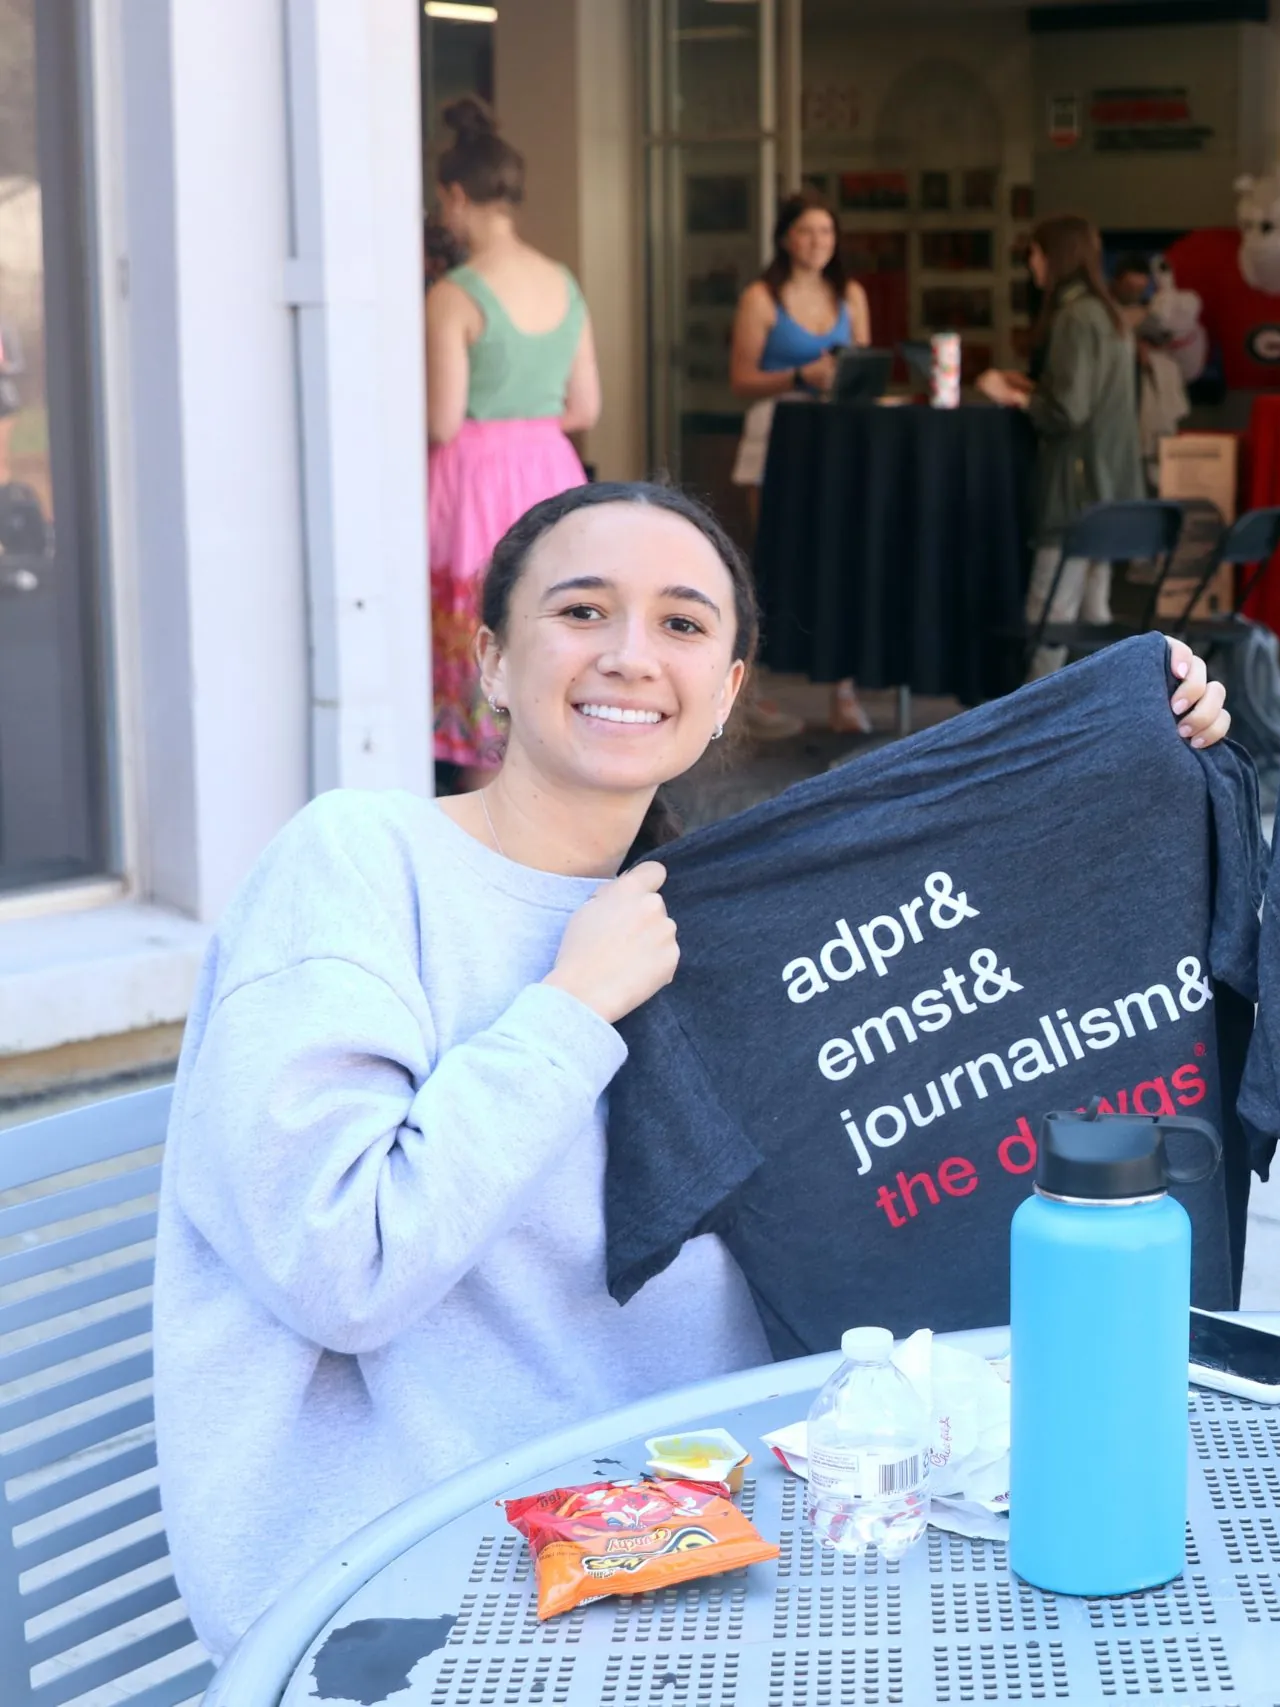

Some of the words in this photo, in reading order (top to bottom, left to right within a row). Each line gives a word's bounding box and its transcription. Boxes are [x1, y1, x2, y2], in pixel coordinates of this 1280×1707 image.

[781, 871, 980, 1004] adpr&
[817, 948, 1024, 1082] emst&
[839, 955, 1214, 1176] journalism&
[875, 1155, 979, 1229] the
[997, 1063, 1208, 1175] dgs
[605, 1527, 672, 1553] Crunchy
